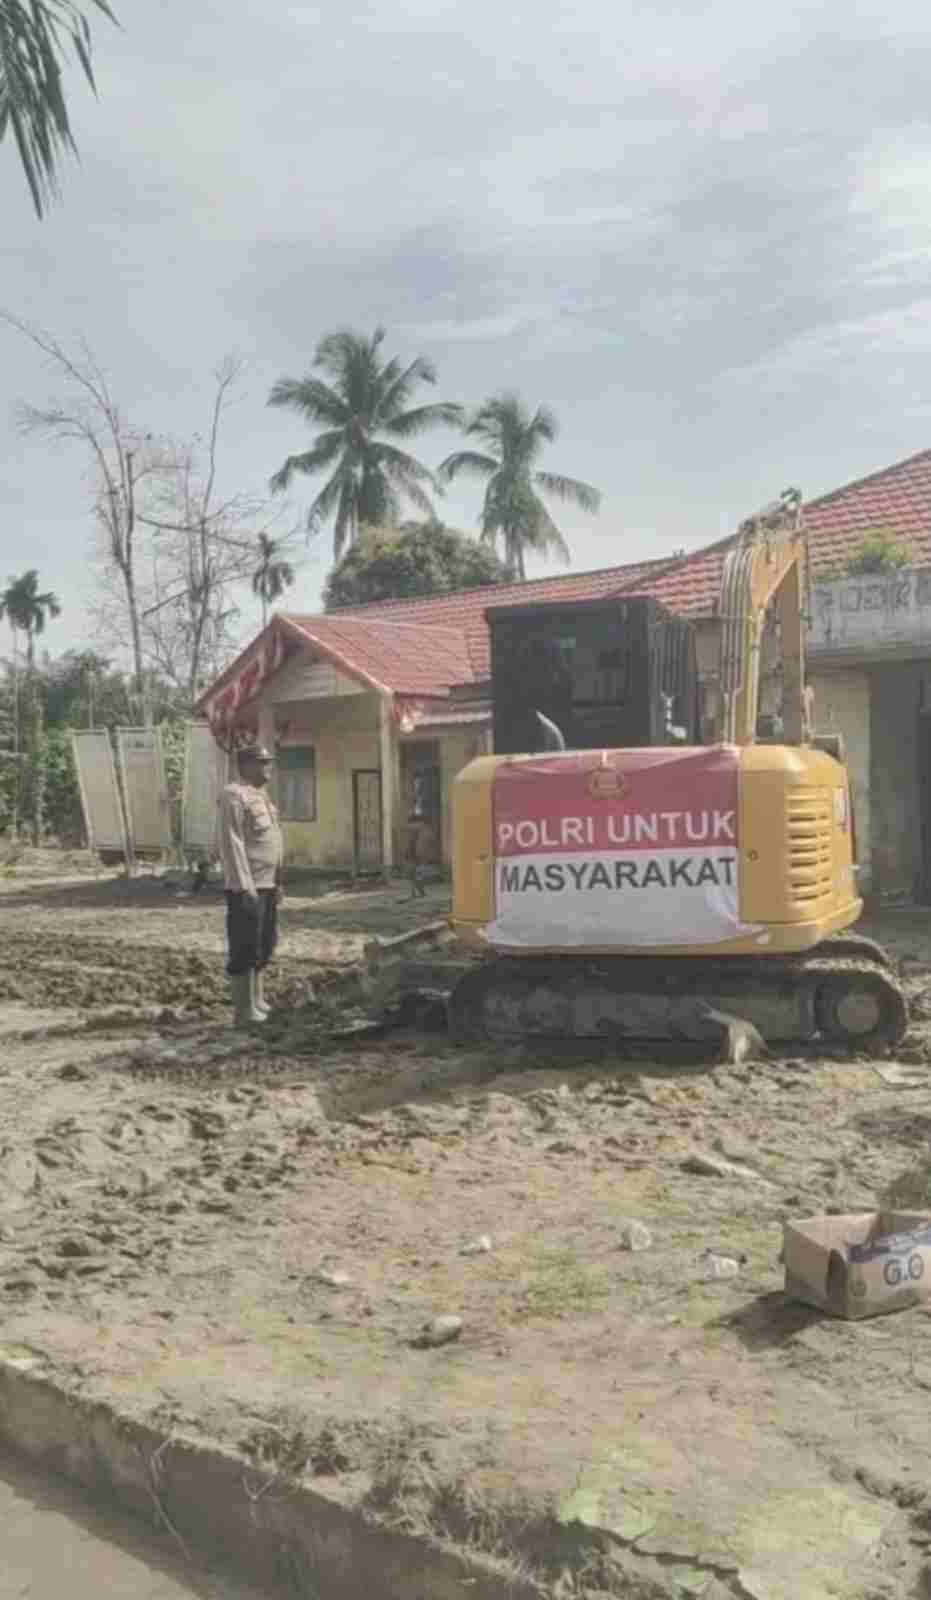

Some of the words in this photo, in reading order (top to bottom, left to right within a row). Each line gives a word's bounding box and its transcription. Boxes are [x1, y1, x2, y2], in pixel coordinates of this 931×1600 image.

[498, 816, 594, 849] POLRI
[608, 810, 737, 843] UNTUK
[500, 857, 736, 892] MASYARAKAT
